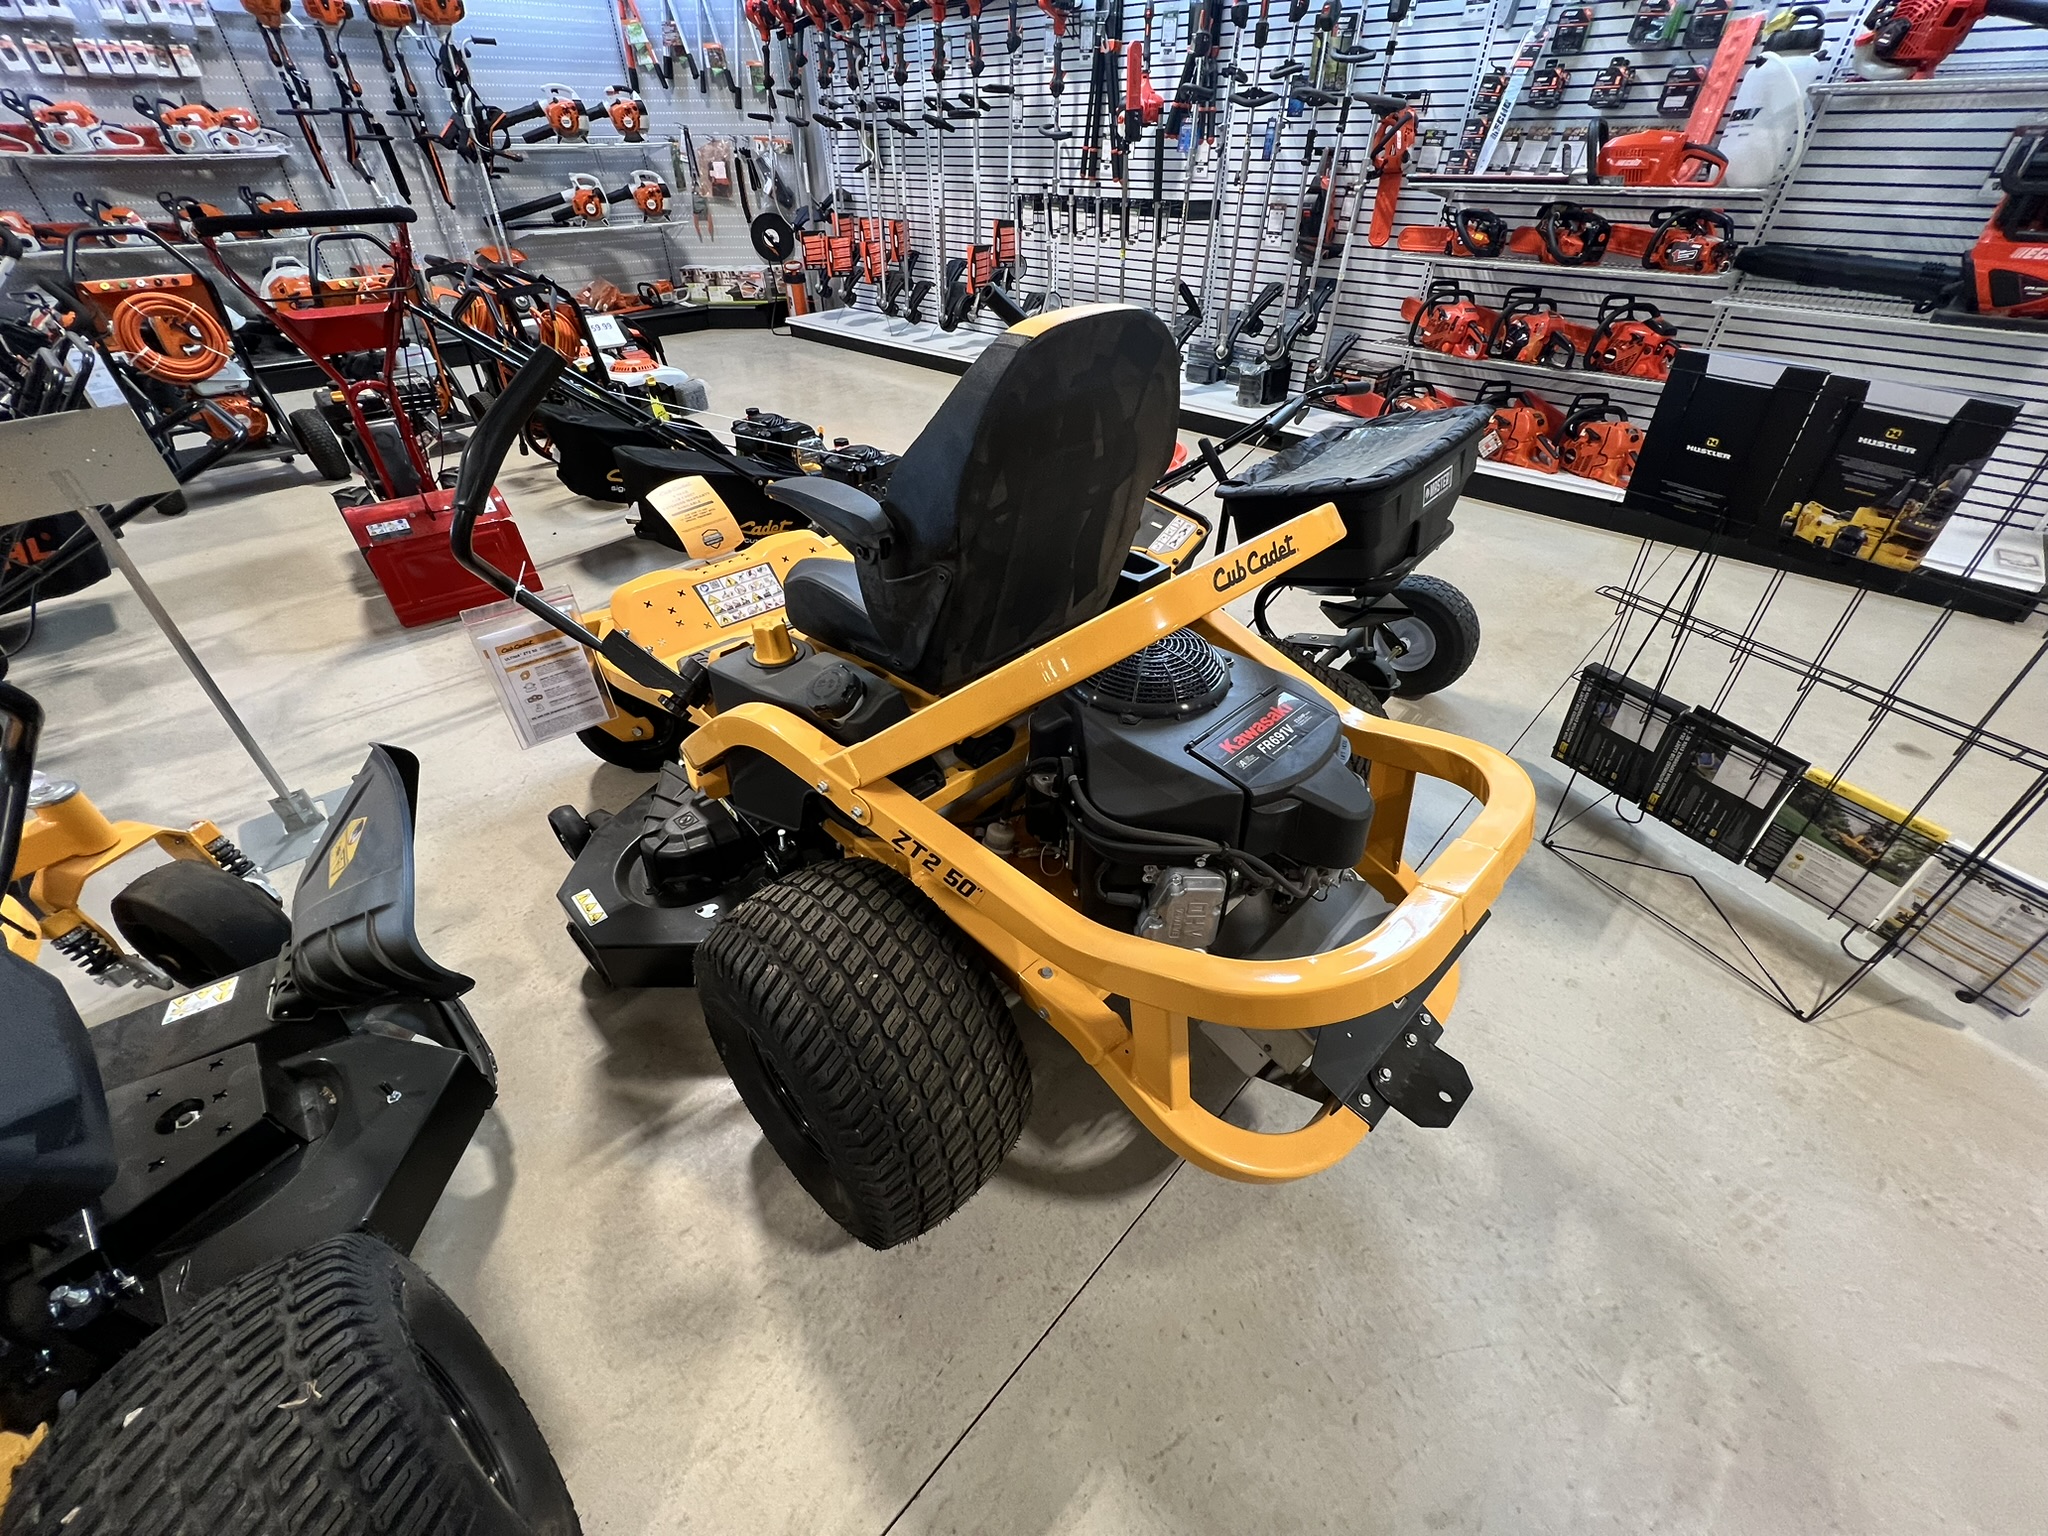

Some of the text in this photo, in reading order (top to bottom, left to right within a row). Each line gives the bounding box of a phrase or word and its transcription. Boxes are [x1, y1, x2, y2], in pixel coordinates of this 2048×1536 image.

[1686, 444, 1731, 460] HUSTLER
[1858, 436, 1917, 454] HUSTLER
[740, 519, 793, 535] Cadet
[1213, 534, 1297, 593] Cub Cadet
[1219, 703, 1294, 755] Kawasaki
[1256, 723, 1295, 754] FR691V
[891, 829, 983, 898] ZT2 50"
